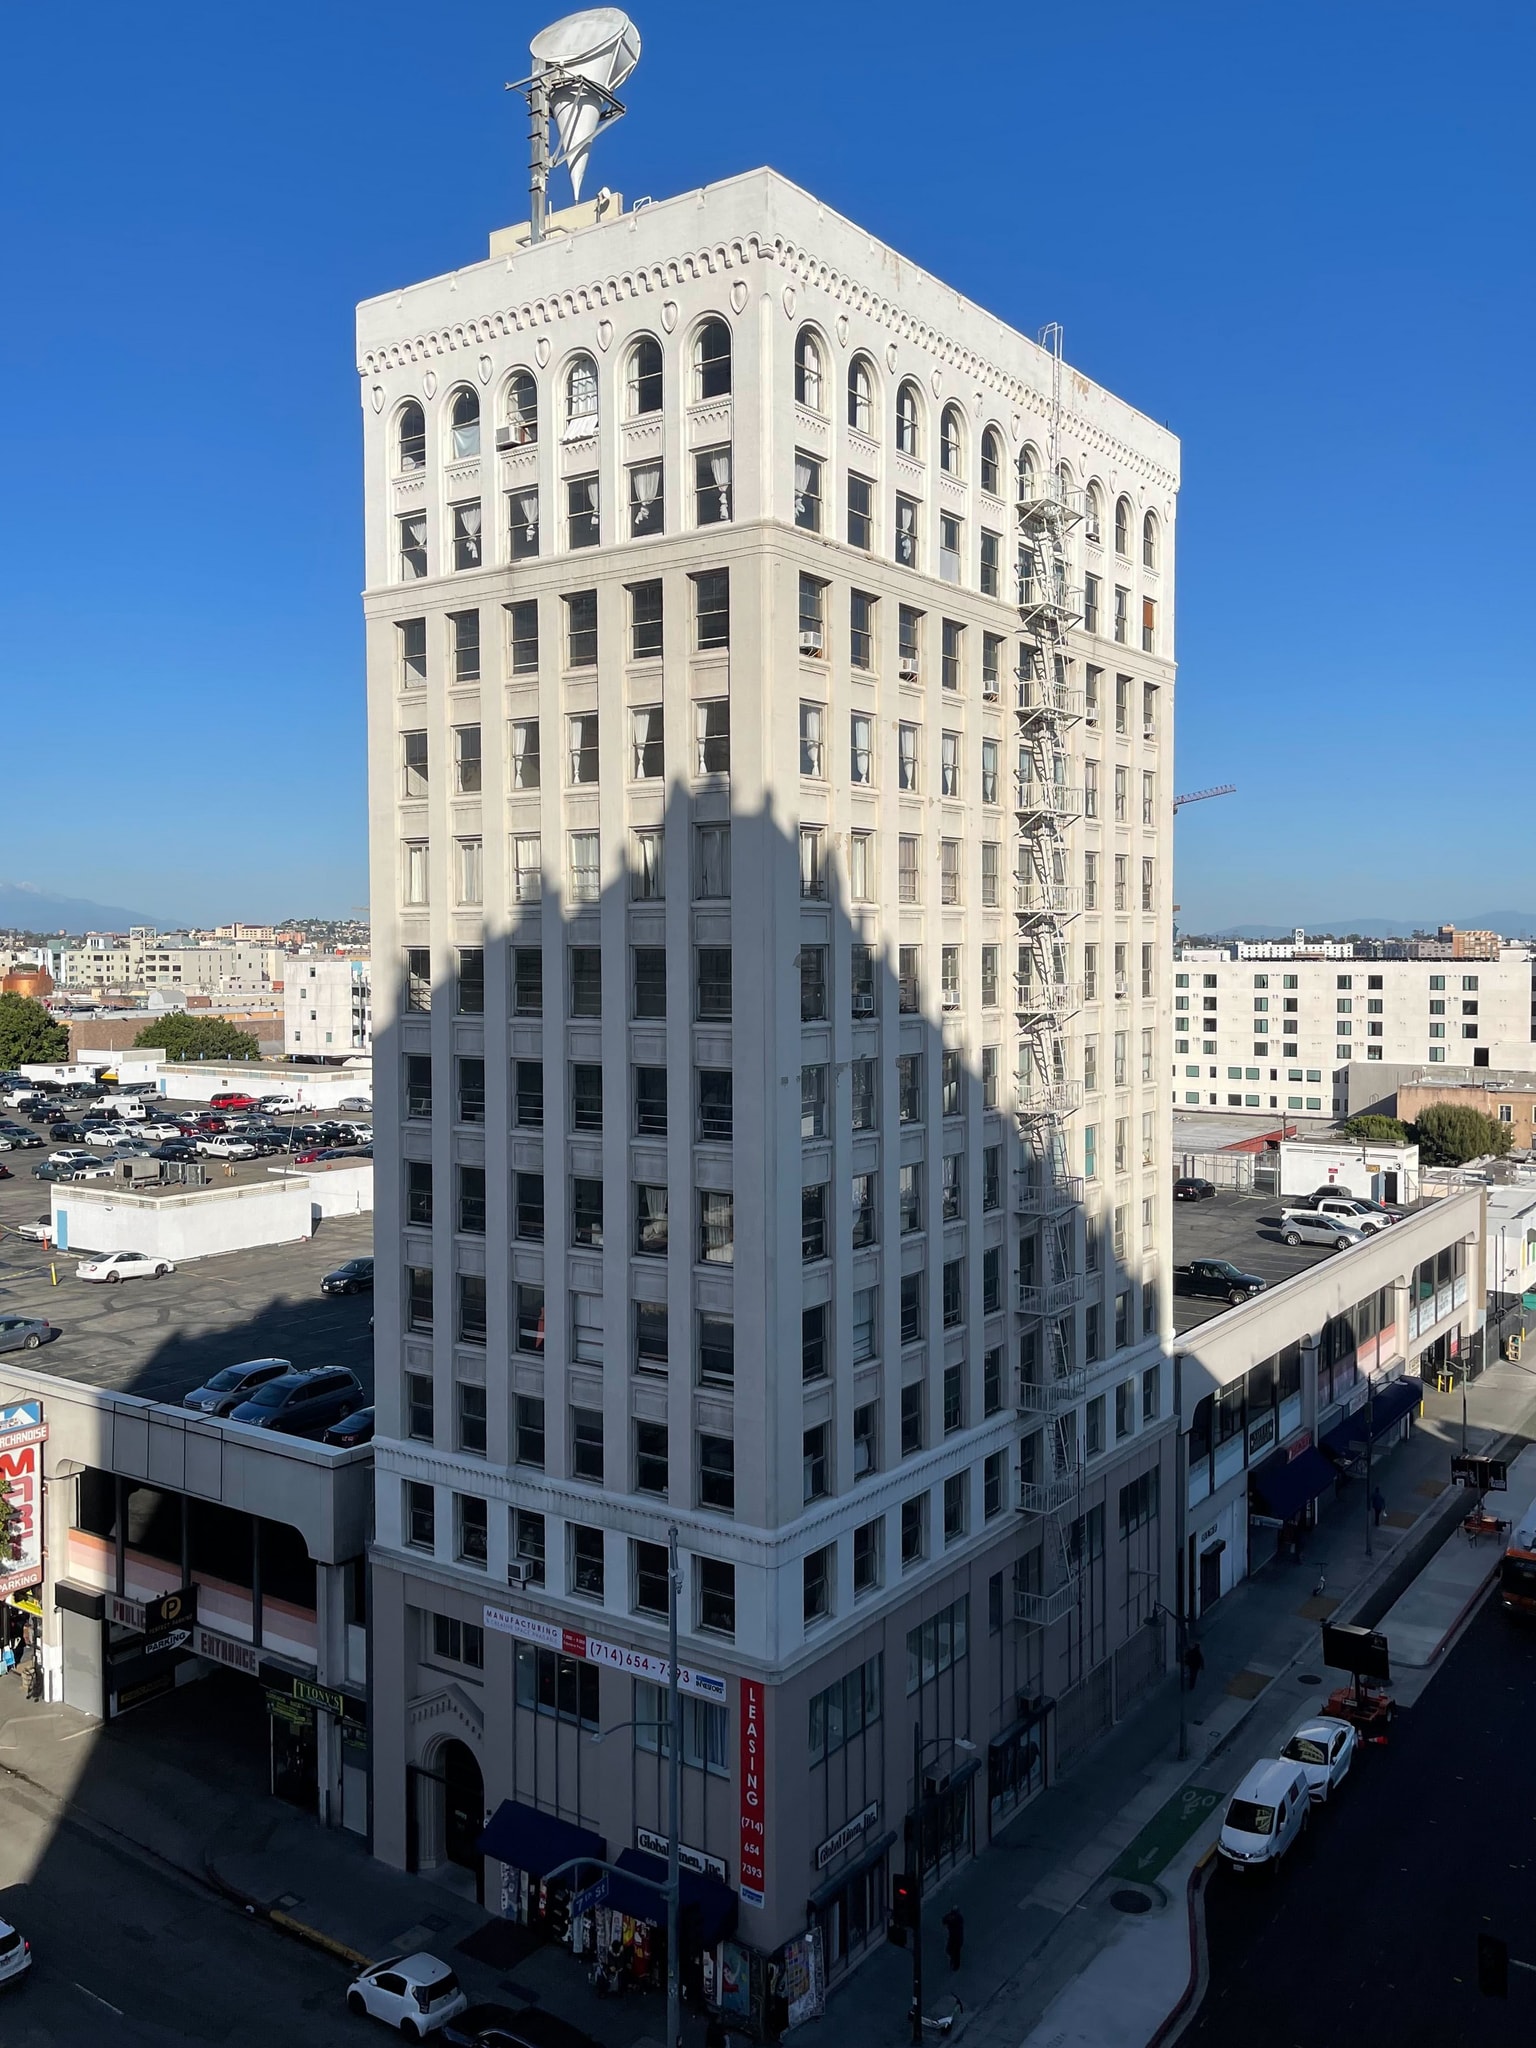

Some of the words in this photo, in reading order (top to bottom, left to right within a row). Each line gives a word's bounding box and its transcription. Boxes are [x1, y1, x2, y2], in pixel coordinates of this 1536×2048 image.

[486, 1609, 558, 1637] MANUFACTURING
[147, 1632, 186, 1652] PARKING
[201, 1633, 256, 1672] ENTRANCE
[590, 1642, 623, 1666] (714)
[746, 1687, 758, 1806] LEASING
[741, 1816, 764, 1836] (714)
[639, 1833, 669, 1857] Global
[678, 1847, 702, 1871] inen,
[744, 1842, 760, 1856] 654
[741, 1862, 762, 1879] 7393
[575, 1893, 592, 1912] 7th
[595, 1884, 606, 1899] St
